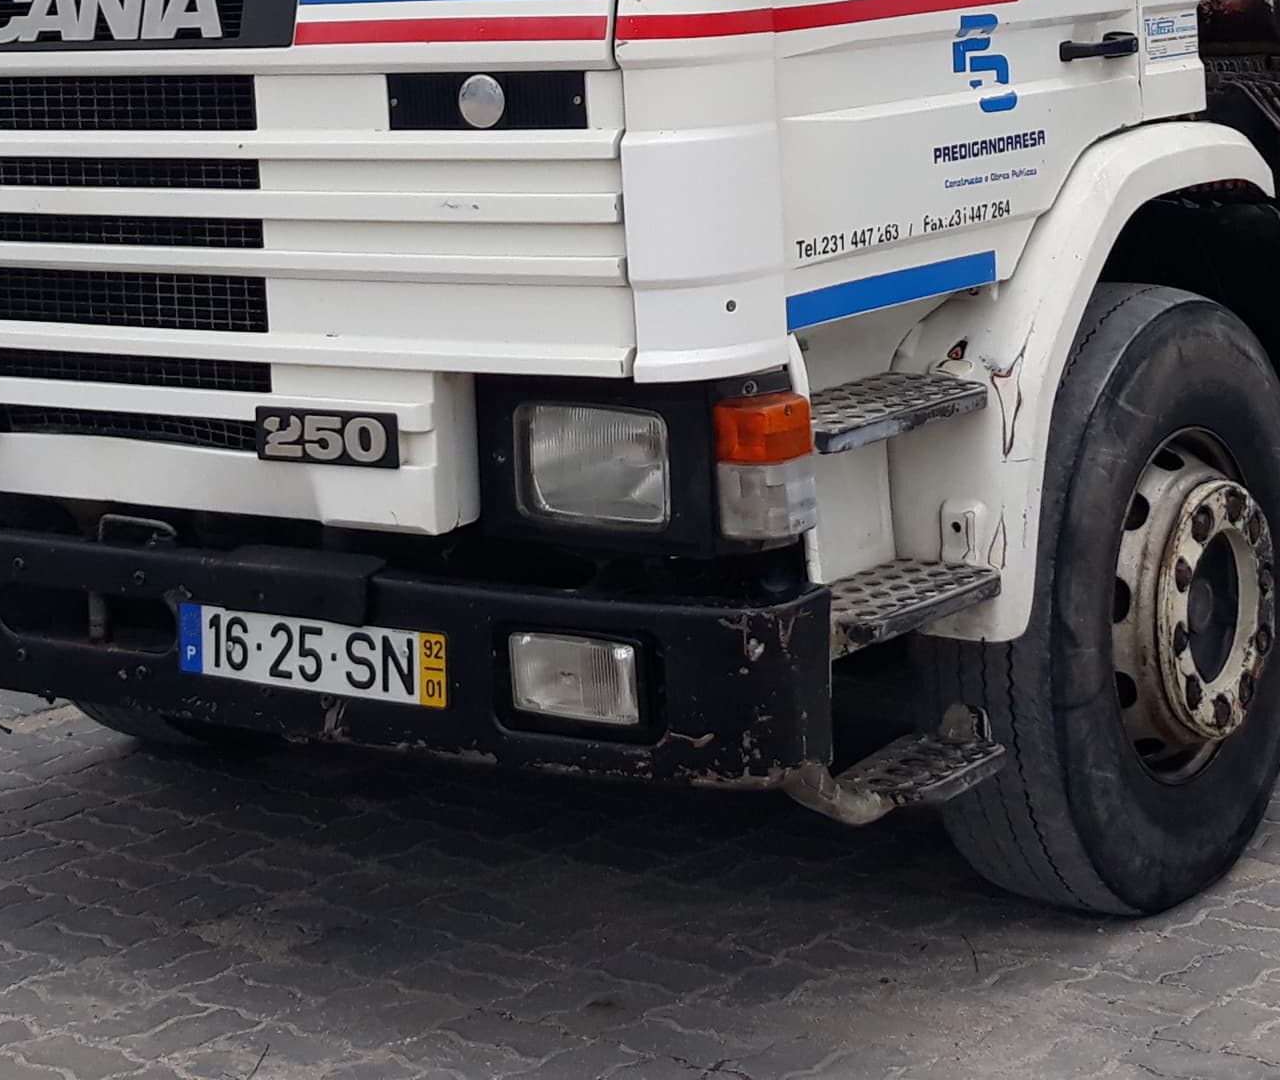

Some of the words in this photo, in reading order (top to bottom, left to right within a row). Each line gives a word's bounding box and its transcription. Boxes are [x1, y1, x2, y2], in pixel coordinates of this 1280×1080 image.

[933, 129, 1046, 165] PREDIGANDARESA
[795, 232, 846, 259] Tel.231
[850, 227, 874, 248] 447
[991, 199, 1011, 219] 264
[262, 414, 387, 463] 250
[186, 644, 197, 661] P
[423, 639, 444, 660] 92
[425, 679, 443, 699] 01
